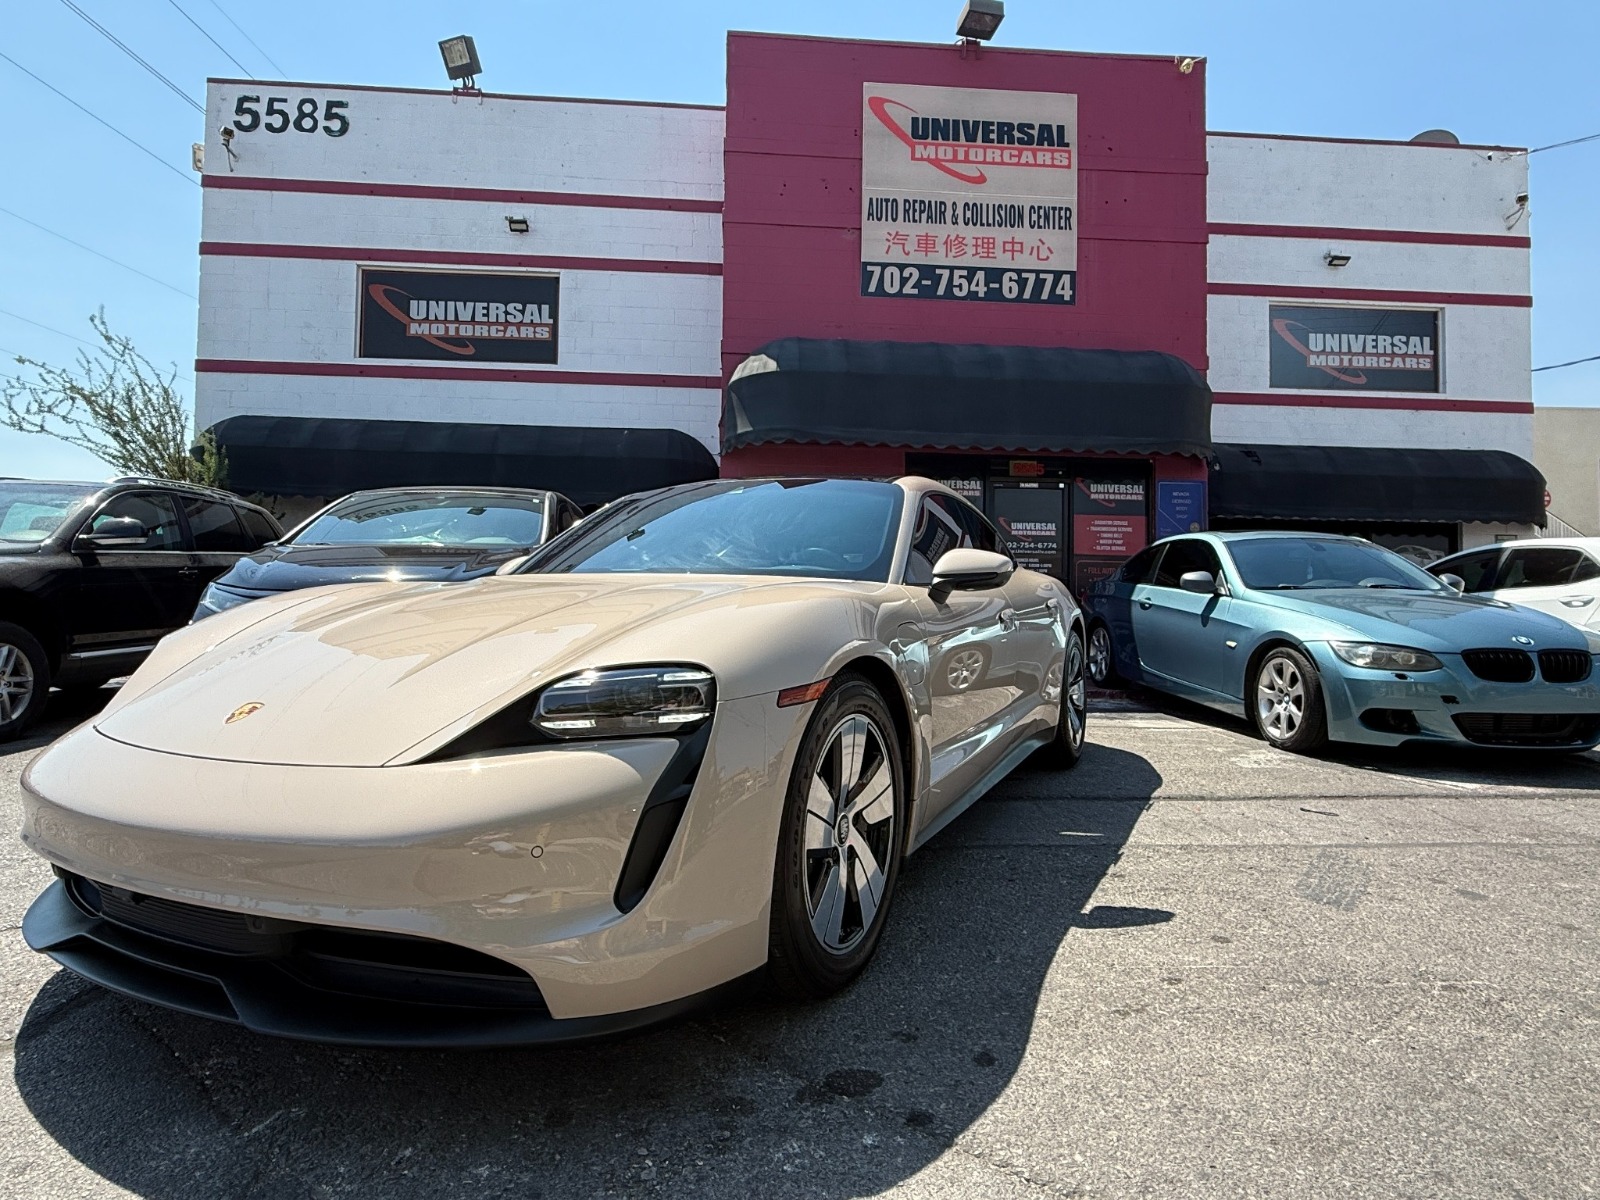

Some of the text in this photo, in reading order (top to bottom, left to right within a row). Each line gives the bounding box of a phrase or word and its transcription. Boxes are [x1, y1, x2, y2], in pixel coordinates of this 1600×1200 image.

[233, 95, 349, 137] 5585
[910, 117, 1070, 148] UNIVERSAL
[914, 144, 1069, 166] MOTORCARS
[867, 197, 1072, 231] AUTO REPAIR & COLLISION CENTER
[885, 231, 1054, 262] 汽車修理中心
[866, 265, 1073, 301] 702-754-6774
[408, 300, 554, 324] UNIVERSAL
[410, 323, 550, 338] MOTORCARS
[1308, 333, 1434, 355] UNIVERSAL
[1309, 354, 1431, 369] MOTORCARS
[1090, 484, 1145, 494] UNIVERSAL
[1011, 522, 1057, 530] UNIVERSAL
